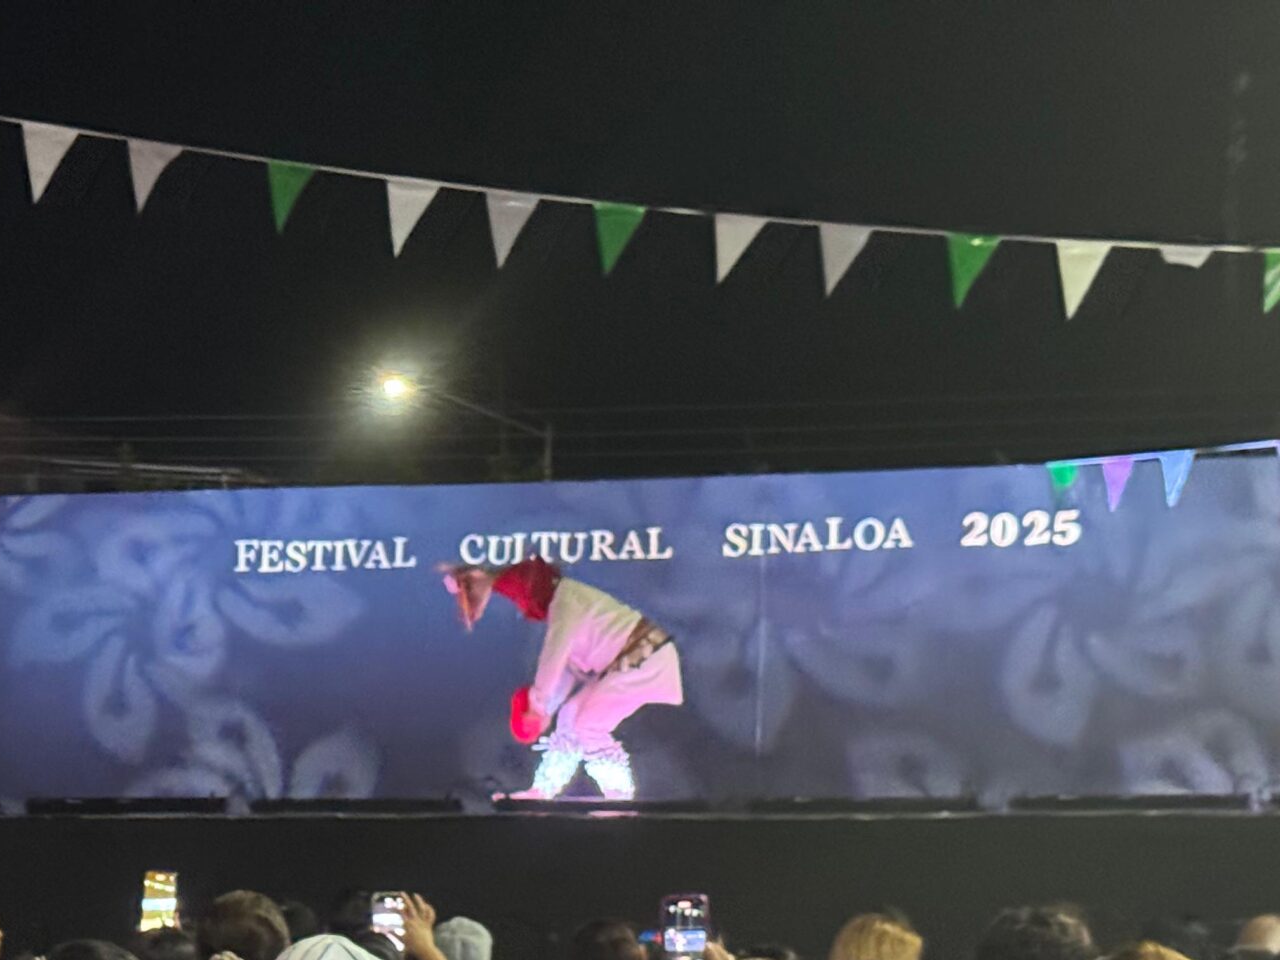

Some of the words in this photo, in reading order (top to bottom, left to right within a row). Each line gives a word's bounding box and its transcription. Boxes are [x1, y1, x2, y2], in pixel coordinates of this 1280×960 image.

[234, 536, 417, 574] FESTIVAL
[458, 526, 674, 566] CULTURAL
[722, 516, 915, 558] SINALOA
[959, 508, 1084, 548] 2025
